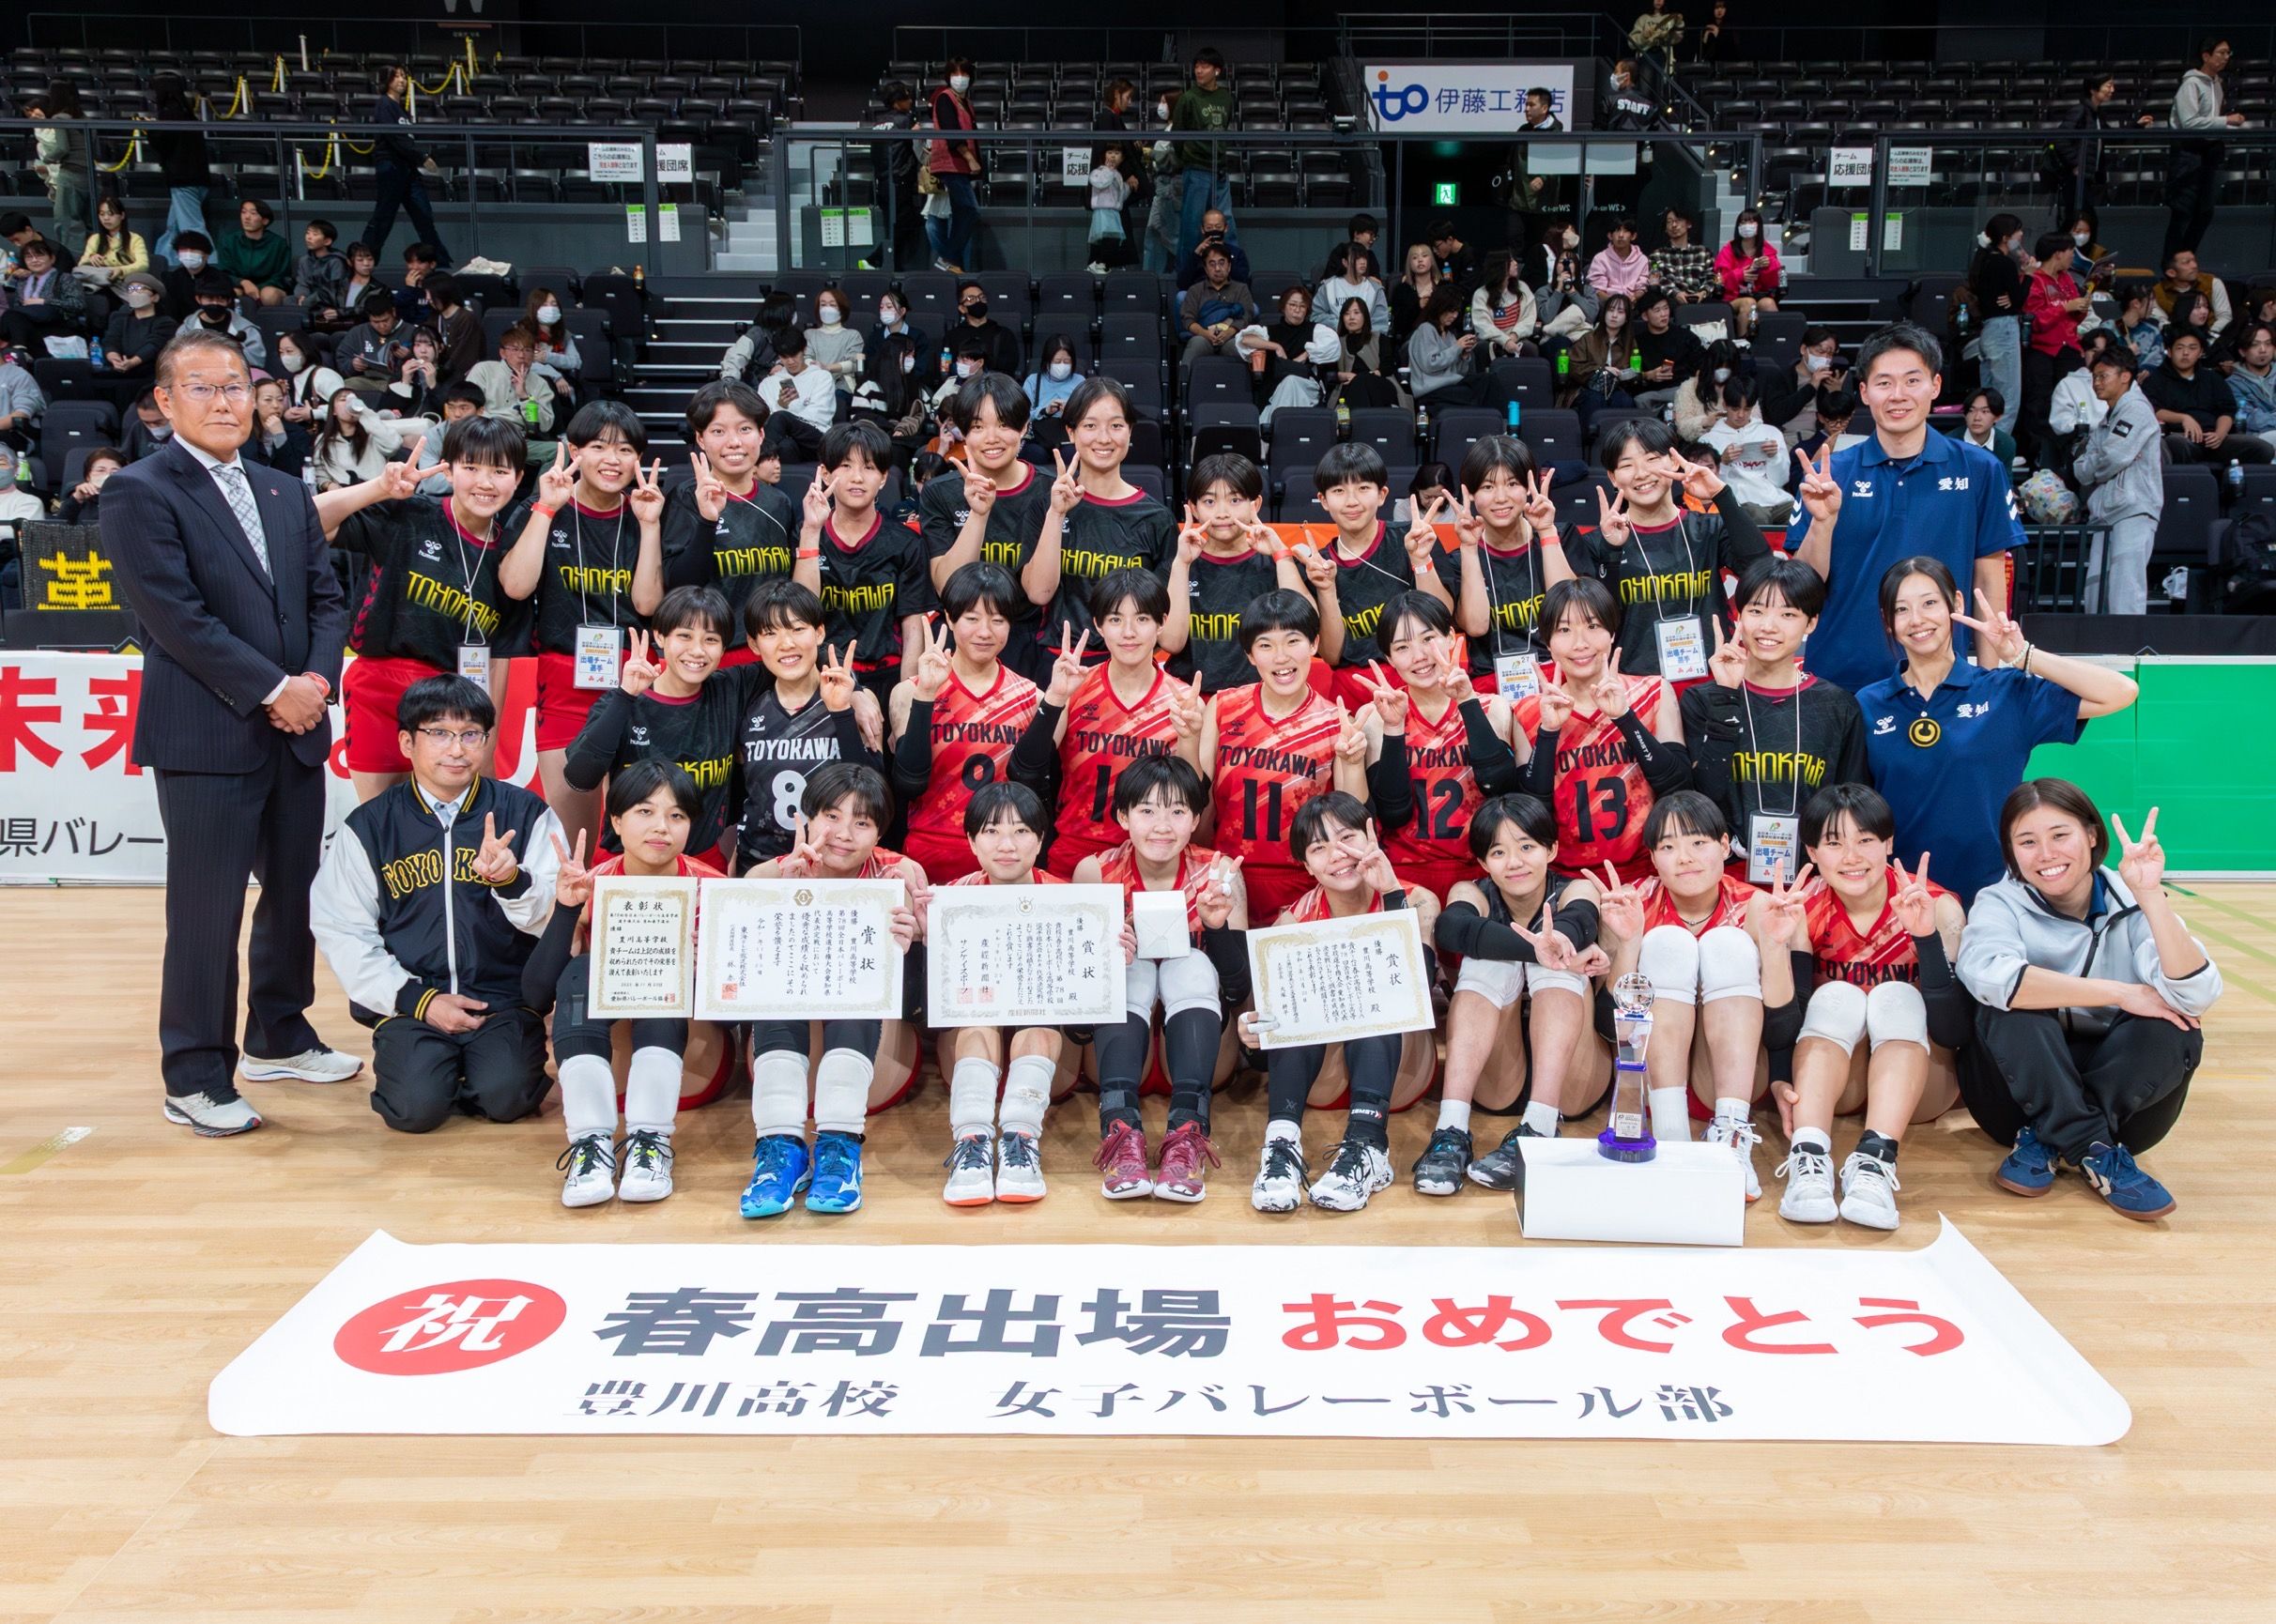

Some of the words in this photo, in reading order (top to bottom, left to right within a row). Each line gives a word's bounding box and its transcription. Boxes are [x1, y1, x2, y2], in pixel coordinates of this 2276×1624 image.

[658, 160, 688, 171] 援団席
[1938, 477, 1969, 491] 愛知
[418, 550, 440, 562] hummel
[559, 565, 632, 596] OYOKA
[1620, 570, 1712, 605] OYOKAWA
[407, 571, 501, 637] TOYOKAWA
[1956, 701, 1990, 719] 愛知
[745, 737, 842, 762] TOYOKAWA
[1220, 746, 1317, 781] TOYOKAWA
[1407, 745, 1472, 769] OYOKAW
[1555, 742, 1635, 774] OYOKAW
[1732, 751, 1826, 789] OYOKAWA
[772, 770, 808, 831] 8
[1090, 765, 1113, 822] 1
[1241, 778, 1282, 841] 11
[1411, 778, 1465, 839] 12
[1575, 776, 1628, 842] 13
[1755, 847, 1792, 858] 出場チーム
[381, 849, 444, 899] TOYO
[623, 901, 663, 911] 表彰状
[851, 910, 858, 925] 優勝
[1077, 918, 1084, 931] 優勝
[849, 938, 857, 984] 豊川高等学校
[860, 925, 876, 970] 賞状
[1082, 940, 1095, 978] 賞状
[1375, 940, 1382, 955] 優勝
[960, 939, 968, 994] サンケイスポーツ
[980, 939, 989, 993] 産経新聞社
[1362, 946, 1376, 993] 豊川高等学校
[1386, 953, 1402, 986] 賞状
[378, 1292, 535, 1355] 祝
[595, 1288, 1230, 1356] 春高出場
[1283, 1294, 1963, 1356] おめでとう
[573, 1380, 898, 1417] 豊川高校
[992, 1381, 1735, 1423] 女子バレーボール部
